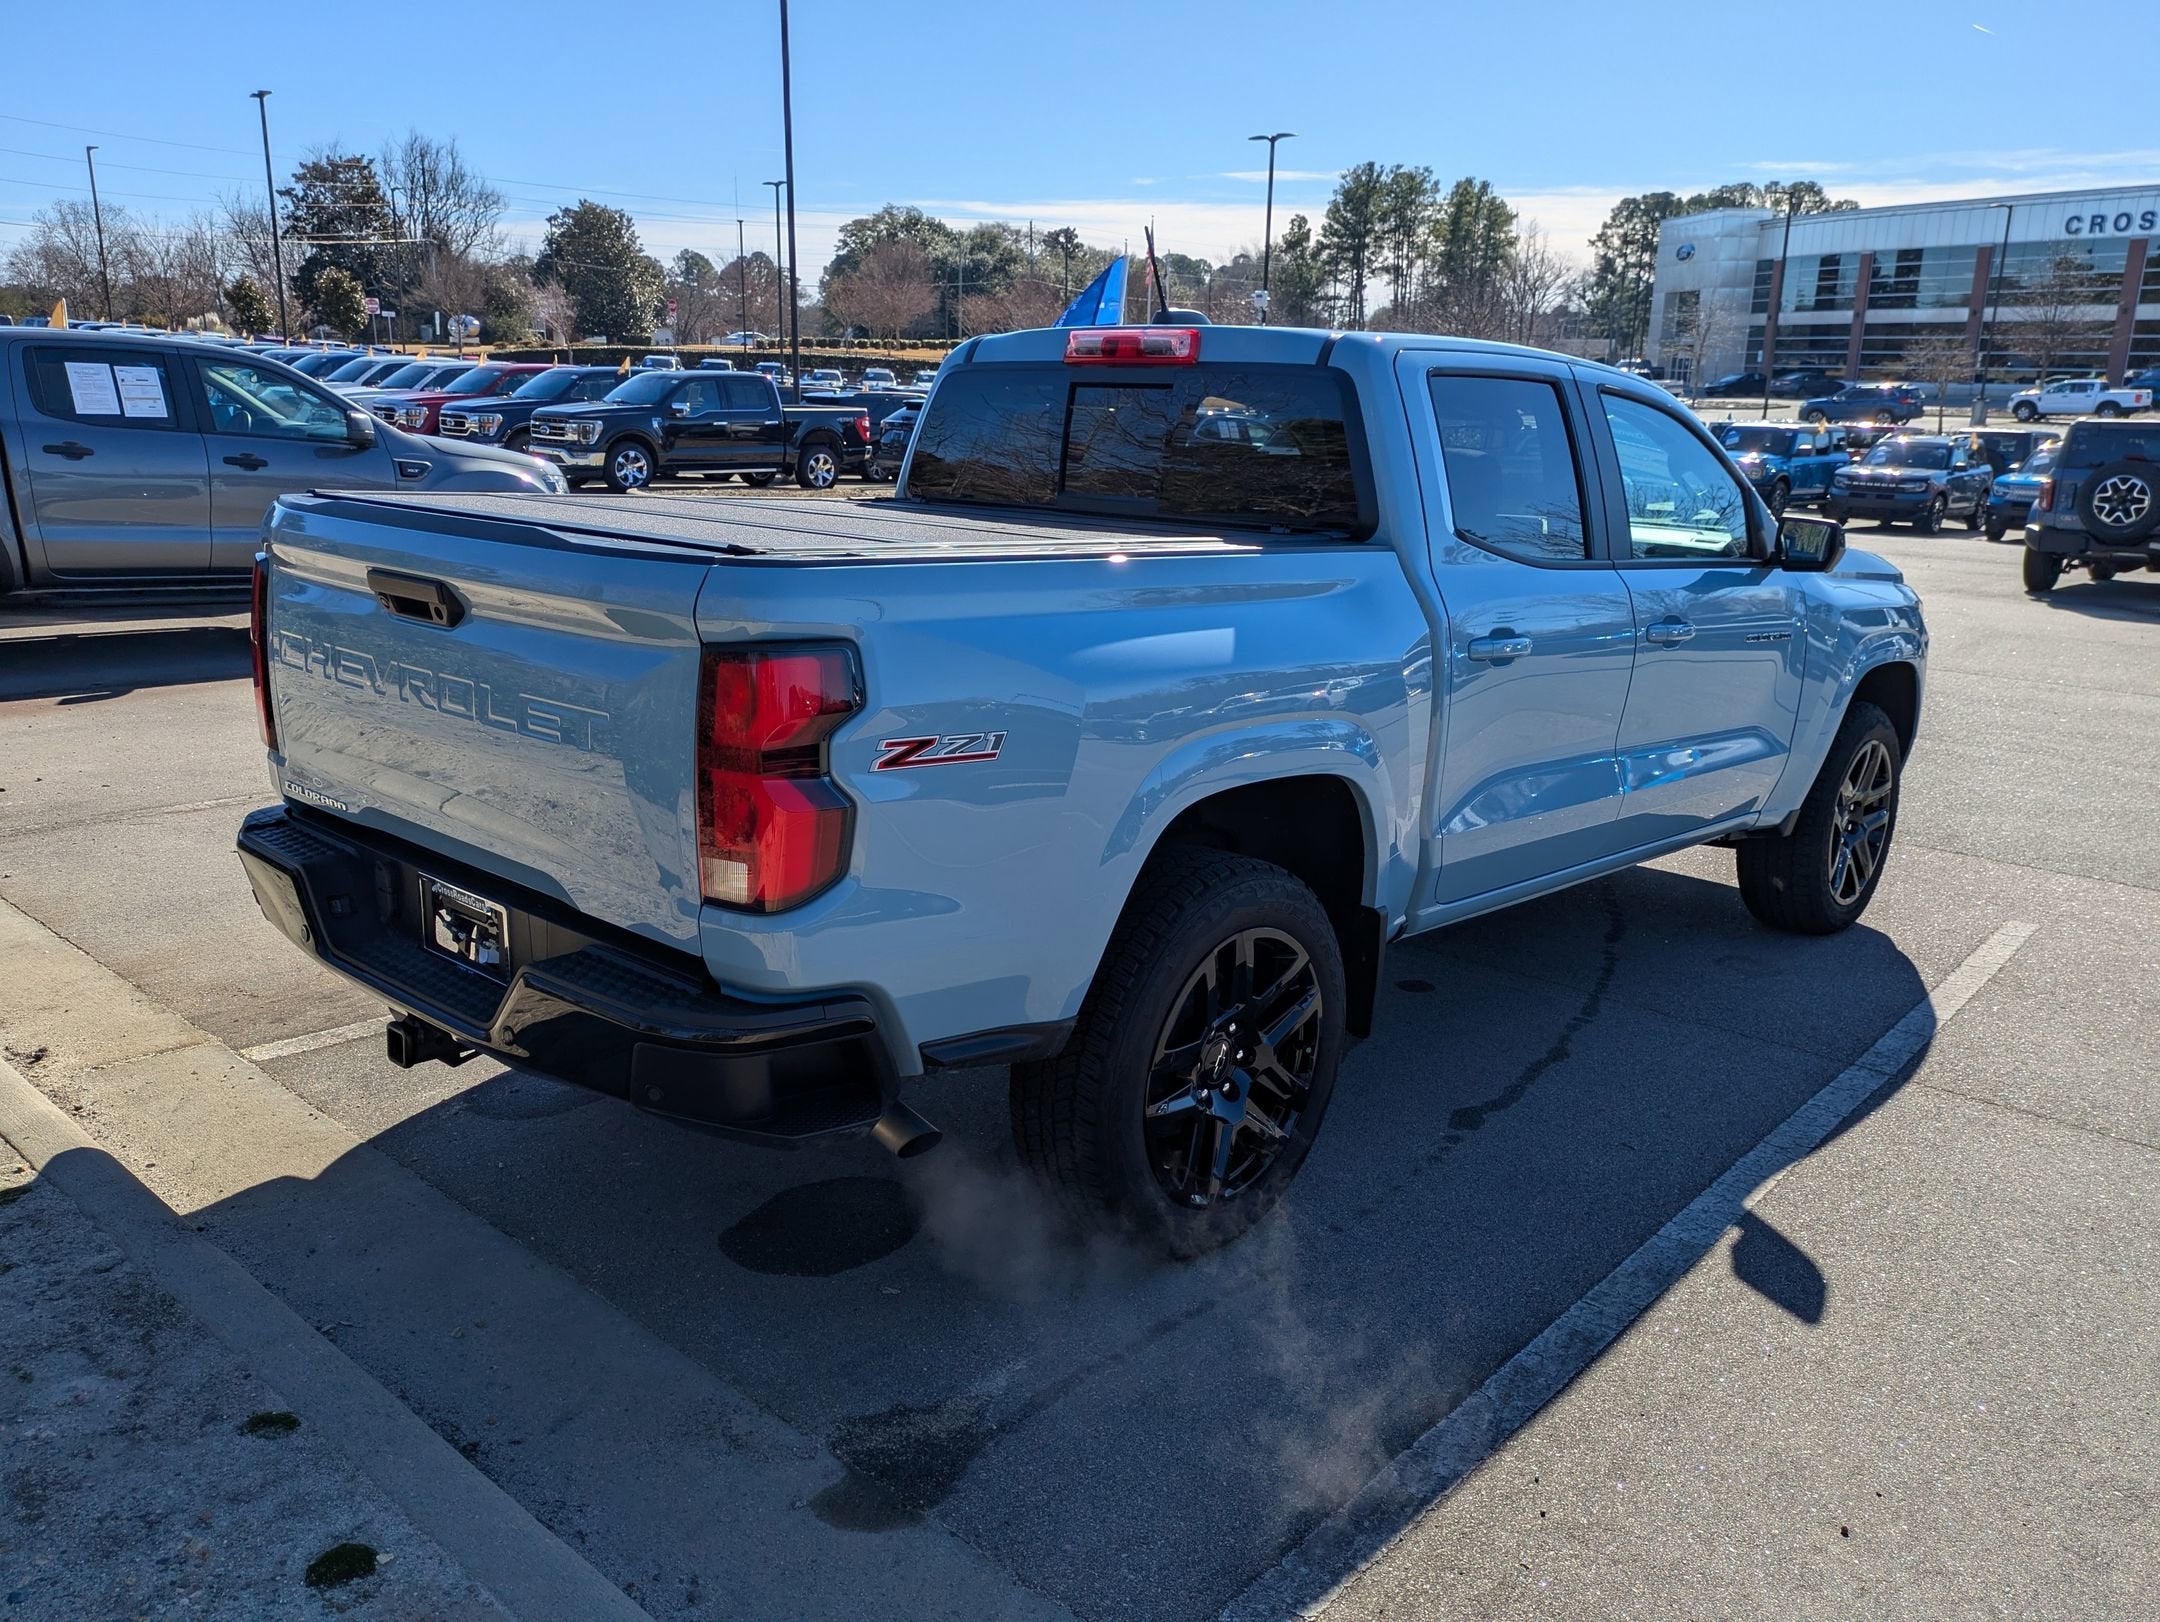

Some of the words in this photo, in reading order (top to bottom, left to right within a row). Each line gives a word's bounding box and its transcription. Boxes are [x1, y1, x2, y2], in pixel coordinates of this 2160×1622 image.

[2065, 210, 2158, 235] CROS
[278, 629, 610, 751] CHEVROLET
[868, 730, 1008, 773] Z71
[285, 780, 347, 811] COLORADO
